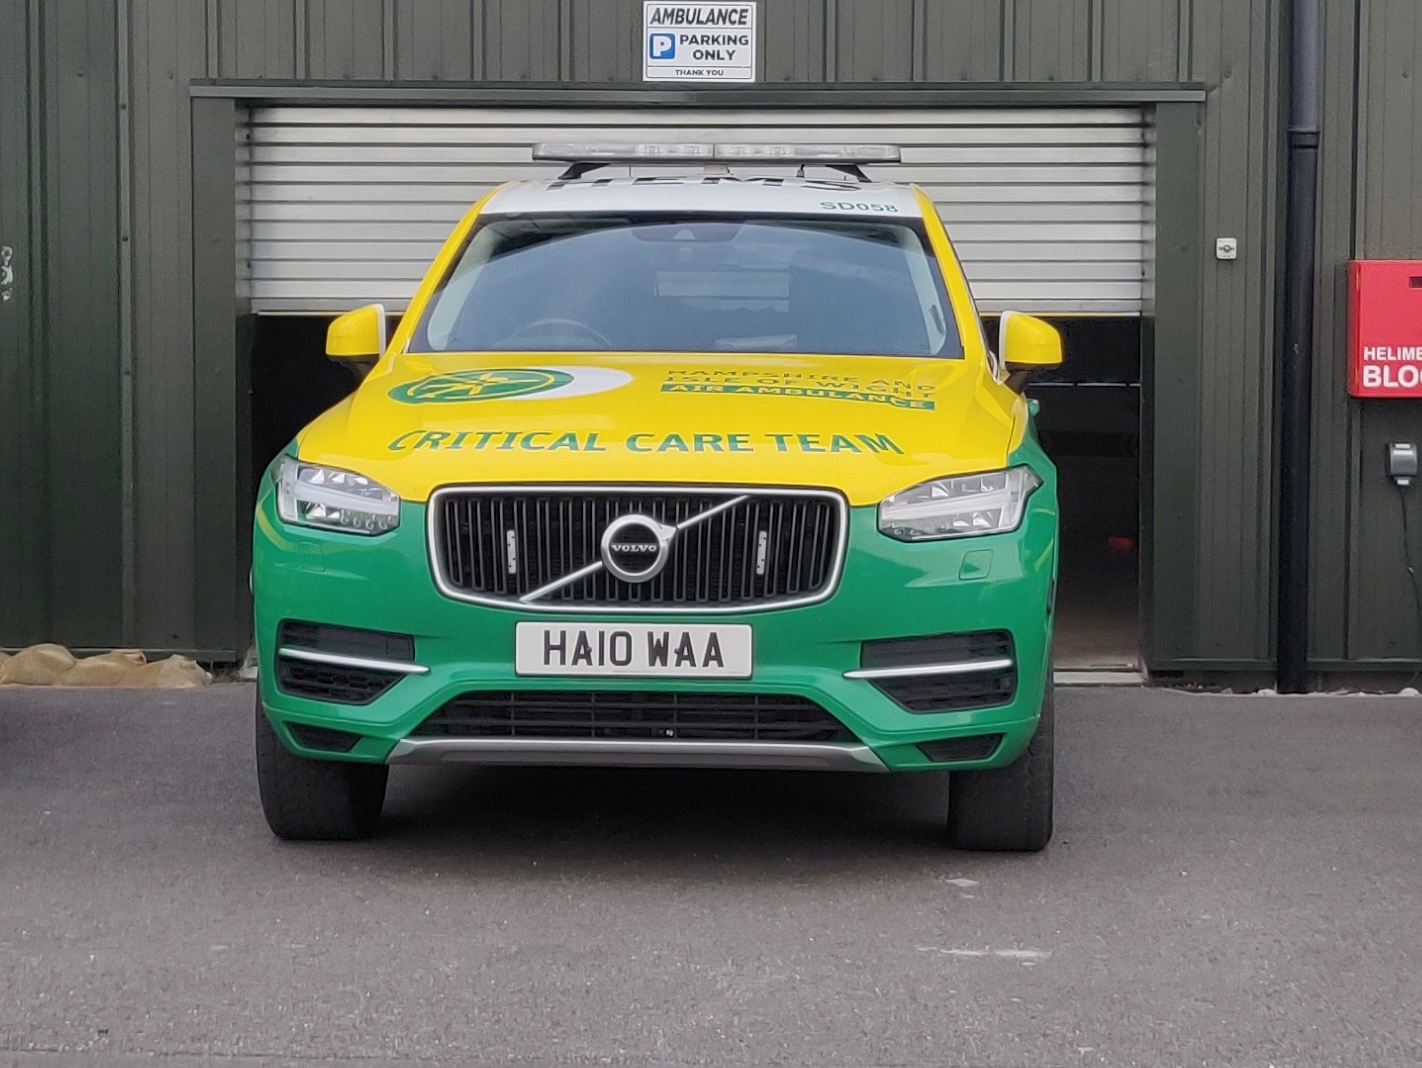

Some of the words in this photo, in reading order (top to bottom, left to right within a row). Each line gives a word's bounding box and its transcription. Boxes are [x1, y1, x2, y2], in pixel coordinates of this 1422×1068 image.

[649, 7, 749, 25] AMBULANCE
[652, 35, 672, 57] P
[679, 34, 749, 46] PARKING
[692, 49, 736, 61] ONLY
[820, 201, 898, 213] SD058
[664, 376, 742, 384] ISLE
[757, 378, 797, 386] OF
[816, 381, 932, 399] WIGHT
[668, 369, 859, 383] HAMPSHIRE
[871, 379, 937, 392] AND
[670, 384, 744, 394] AIR
[746, 386, 927, 409] AMBULANCE
[387, 428, 609, 453] CRITICAL
[623, 433, 755, 453] CARE
[764, 432, 905, 456] TEAM
[610, 544, 658, 553] VOLVO
[543, 629, 633, 667] HA10
[647, 631, 725, 668] WAA
